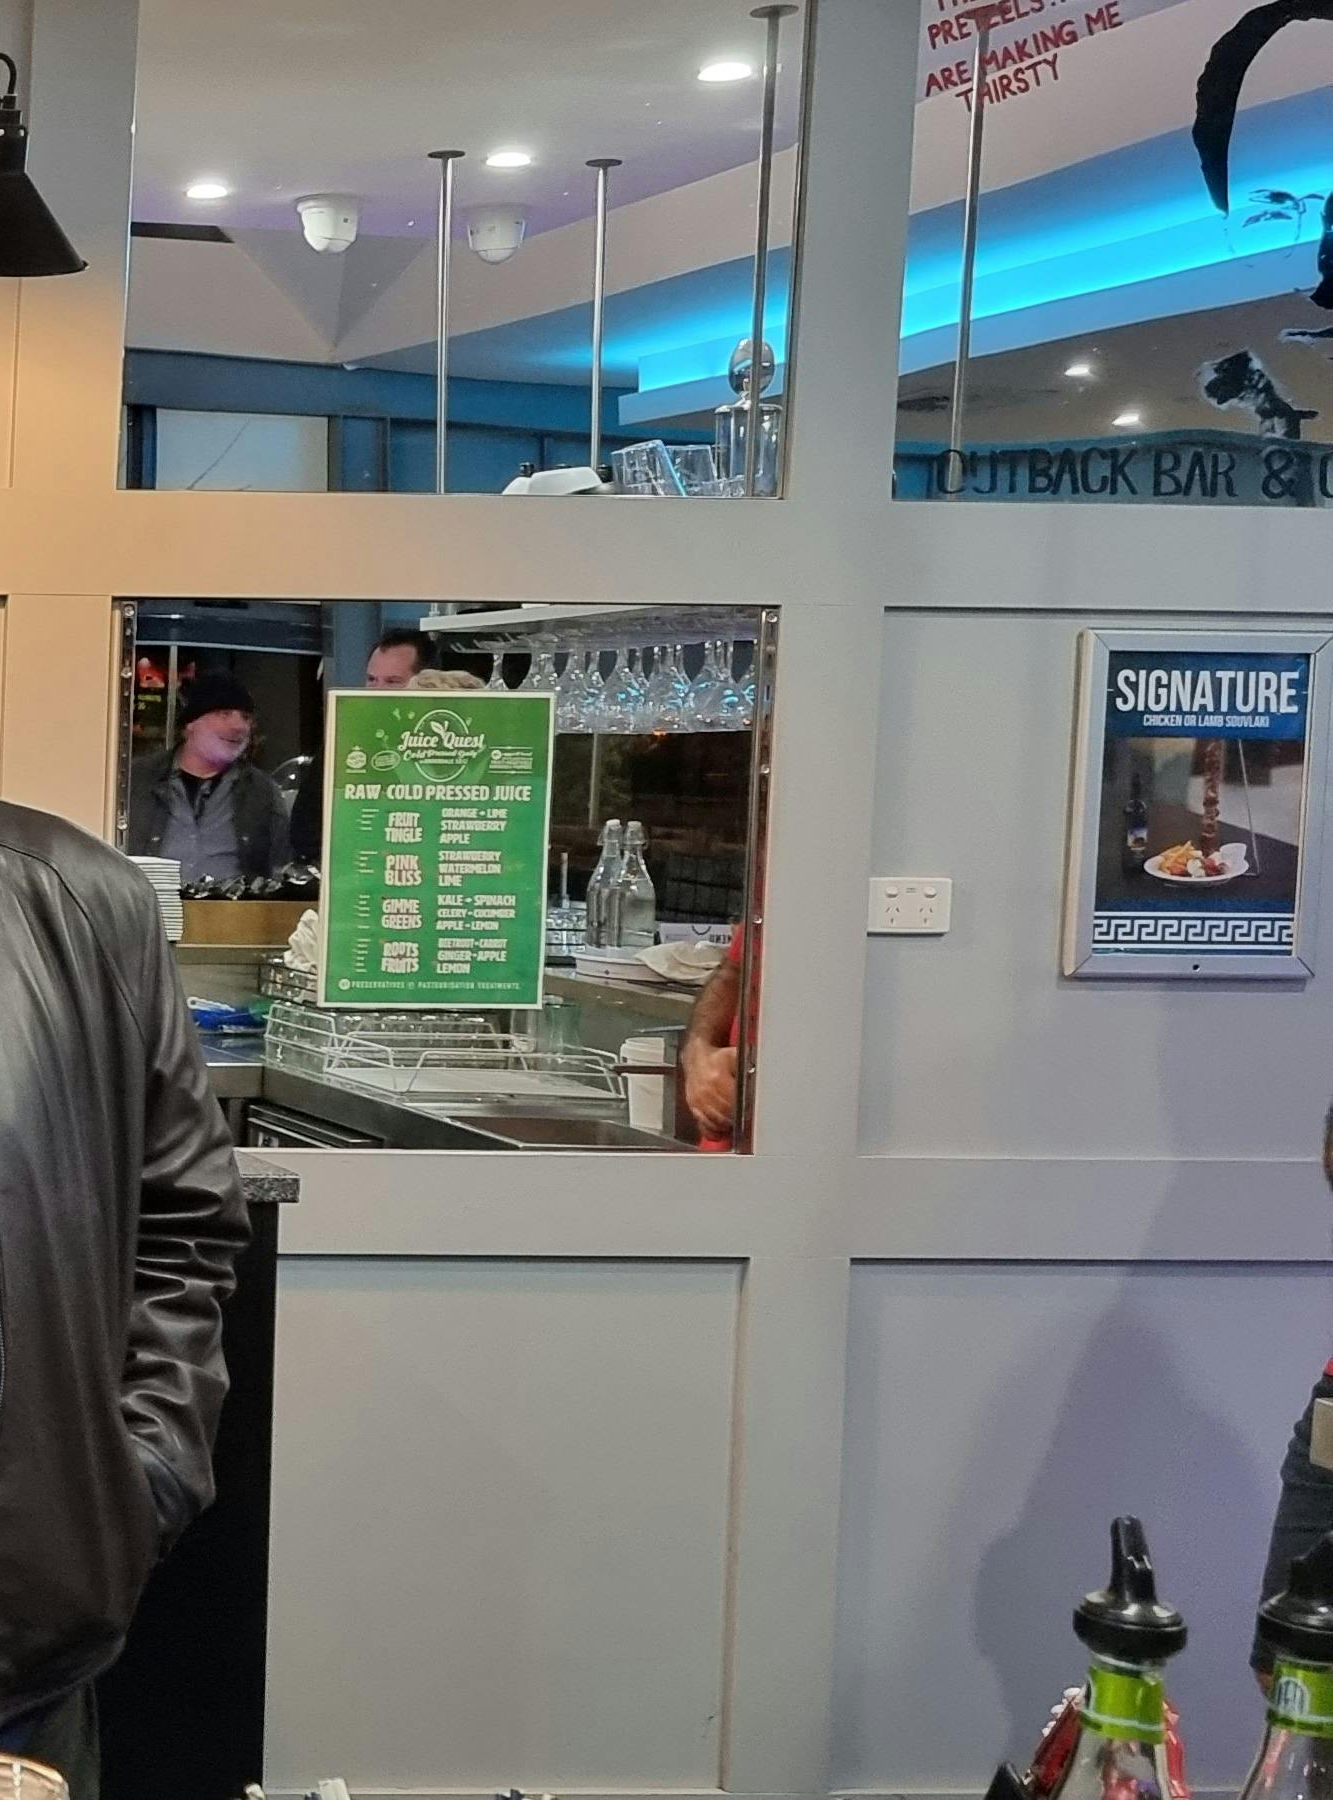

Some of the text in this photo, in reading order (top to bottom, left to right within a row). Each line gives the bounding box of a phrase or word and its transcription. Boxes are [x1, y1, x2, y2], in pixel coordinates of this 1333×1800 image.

[925, 1, 1124, 97] ARE MAKING ME
[955, 53, 1059, 112] THIRSTY
[936, 447, 1139, 495] OUTBACK
[1153, 449, 1238, 498] BAR
[1261, 449, 1301, 499] &
[1115, 669, 1300, 714] SIGNATURE
[1143, 714, 1270, 728] CHICKEN OR LAMB SOUVLAKI
[398, 731, 485, 751] Juice Quest
[345, 783, 531, 802] RAW COLD PRESSED JUICE
[388, 812, 421, 828] FRUIT
[442, 808, 509, 818] ORANGE LIME
[440, 820, 507, 831] STRAWBERRY
[385, 828, 423, 843] TINGLE
[439, 833, 470, 844] APPLE
[385, 855, 419, 870] PINK
[438, 851, 502, 862] STRAWBERRY
[438, 863, 502, 874] WATERMELON
[385, 870, 422, 886] BLISS
[438, 875, 462, 887] LIME
[382, 899, 420, 914] GIMME
[437, 894, 516, 907] KALE SPINACH
[437, 908, 516, 919] CELERY CUCUMBER
[381, 914, 422, 930] GREENS
[436, 921, 499, 931] APPLE LEMON
[382, 942, 419, 958] ROOTS
[437, 951, 508, 962] GINGER APPLE
[436, 963, 471, 974] LEMON
